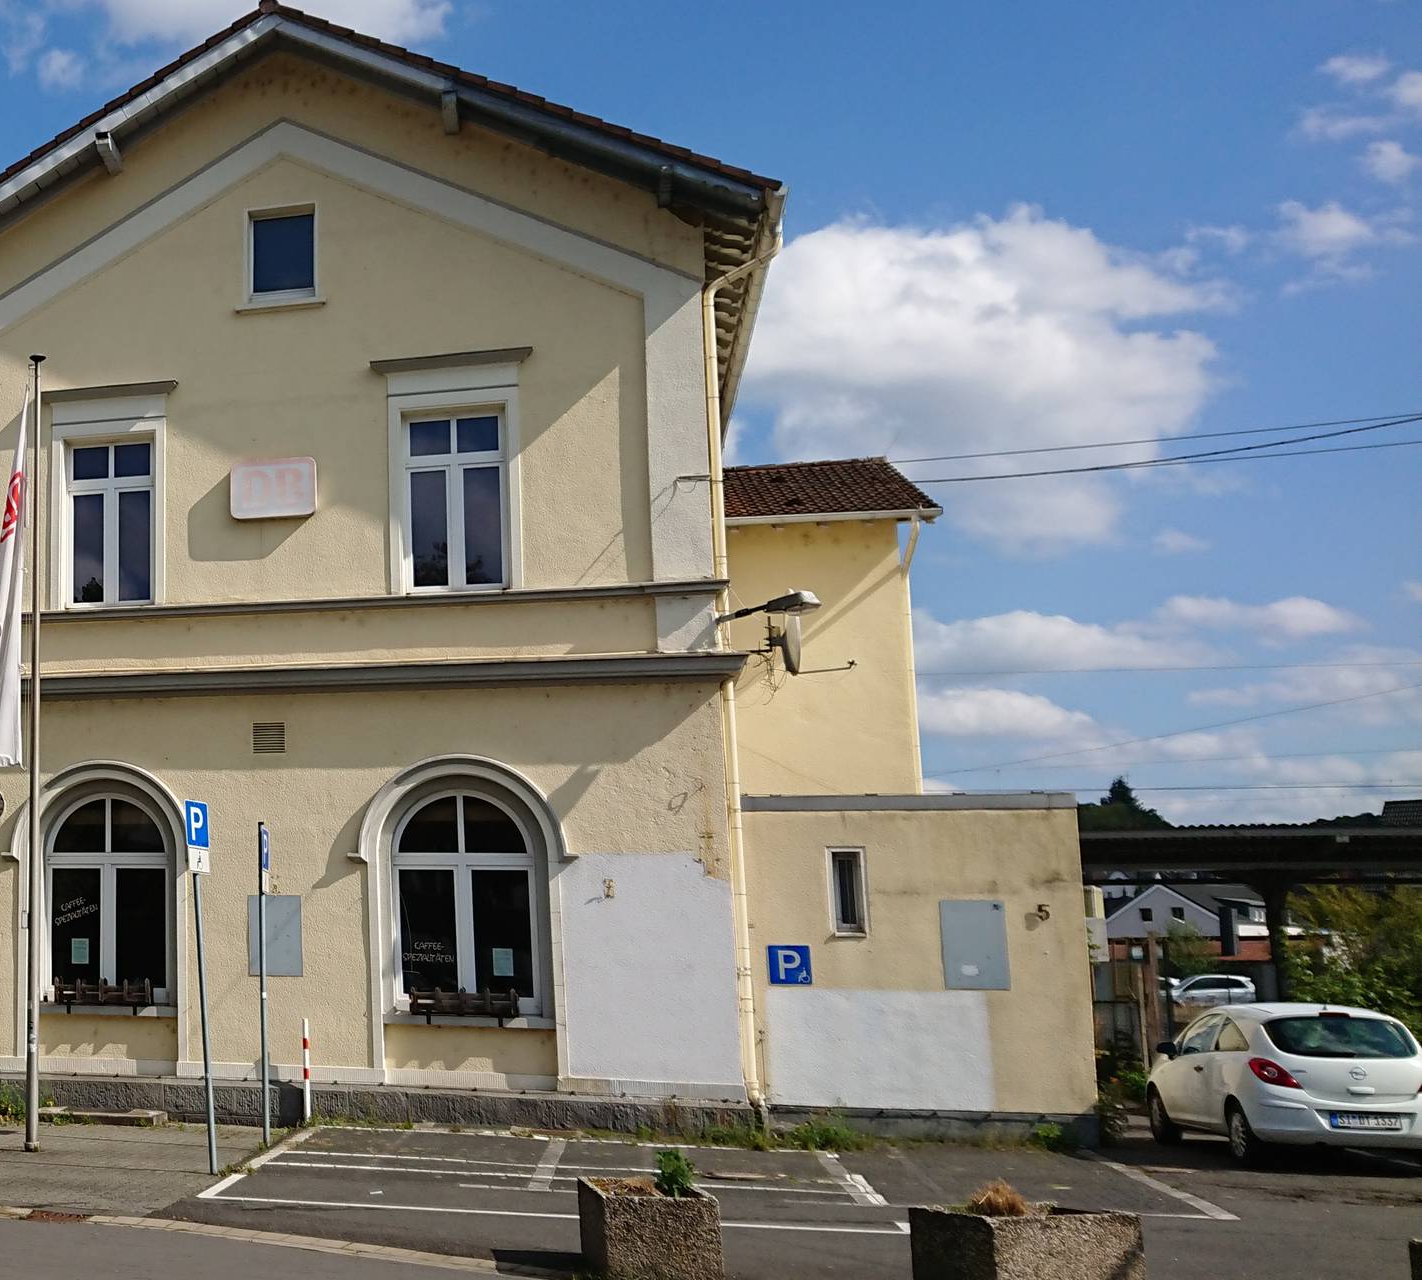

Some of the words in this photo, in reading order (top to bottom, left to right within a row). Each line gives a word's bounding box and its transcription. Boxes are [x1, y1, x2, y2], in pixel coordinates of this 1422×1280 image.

[241, 468, 306, 507] DB
[189, 806, 204, 841] P
[1037, 904, 1050, 921] 5
[778, 950, 801, 980] P
